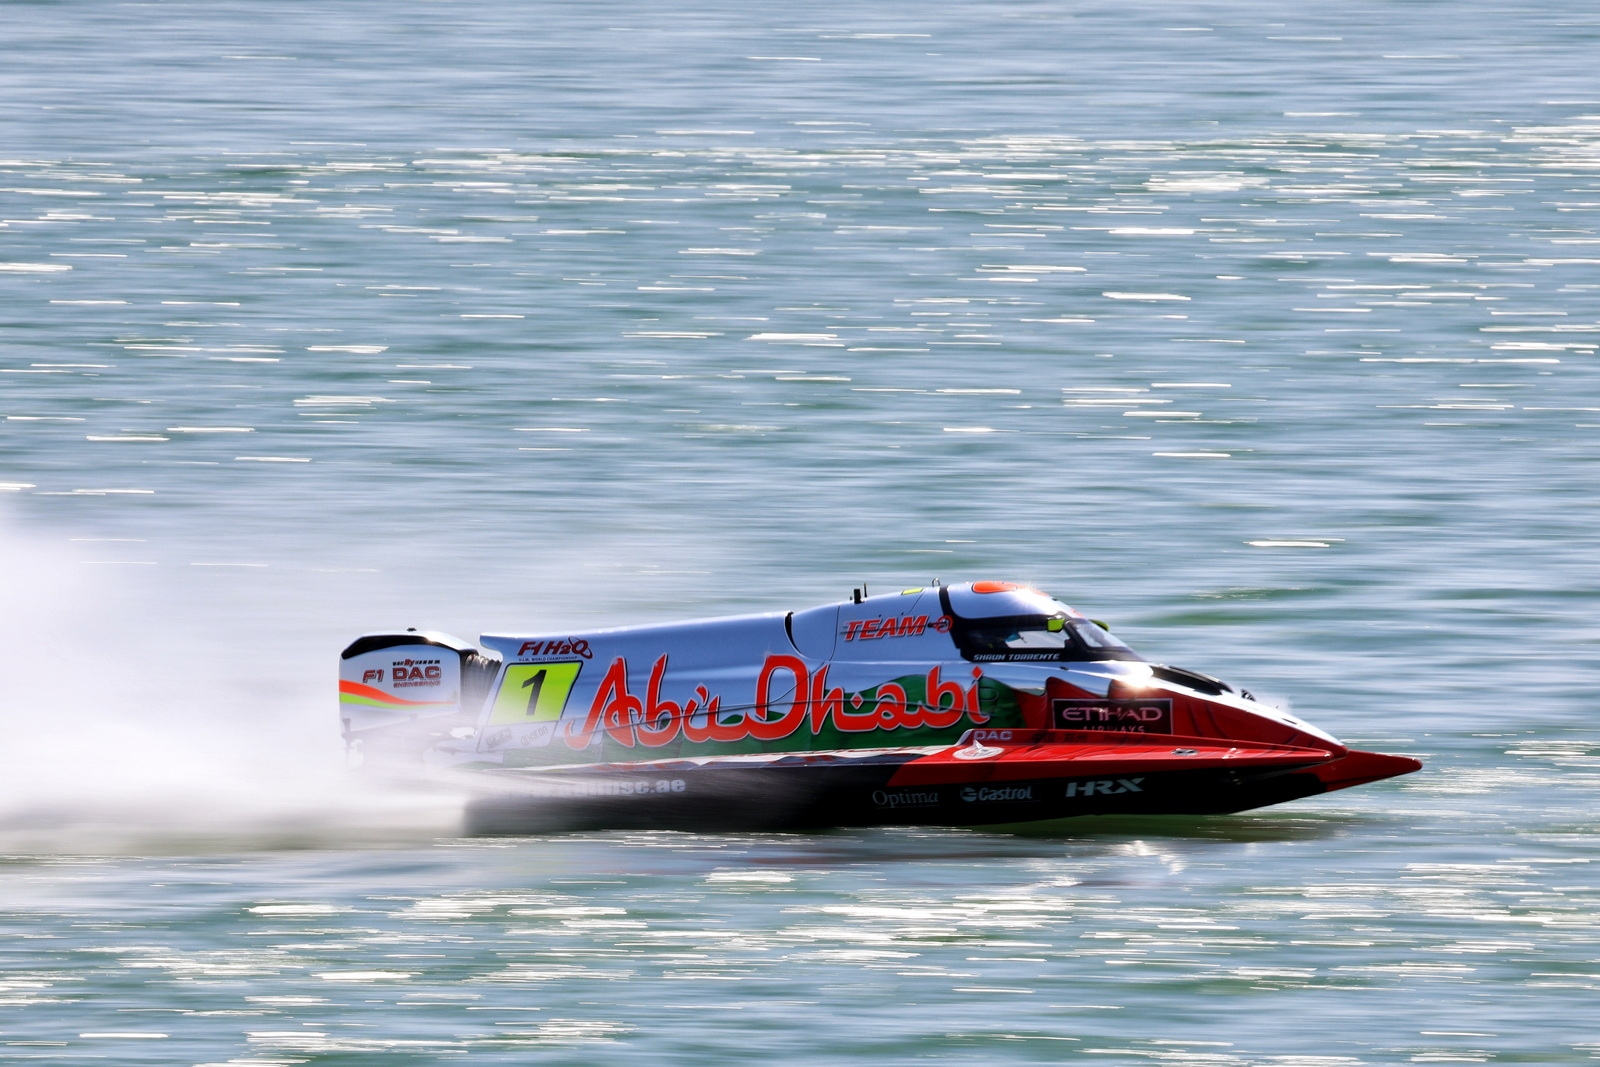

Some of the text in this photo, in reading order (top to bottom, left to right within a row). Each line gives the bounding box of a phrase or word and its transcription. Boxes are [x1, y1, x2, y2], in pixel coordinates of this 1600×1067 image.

[844, 614, 929, 642] TEAM
[973, 652, 1060, 661] SHAUN TORRENTE
[362, 668, 385, 683] F1
[392, 665, 441, 681] DAC
[393, 680, 441, 688] ENGINEERING
[521, 669, 547, 716] 1
[563, 653, 990, 751] Abu Dhabi
[1062, 707, 1163, 721] ETIHAD
[973, 730, 1013, 740] DAC
[978, 786, 1033, 802] Castrol
[1066, 777, 1145, 797] HRX
[872, 788, 938, 808] Optima
